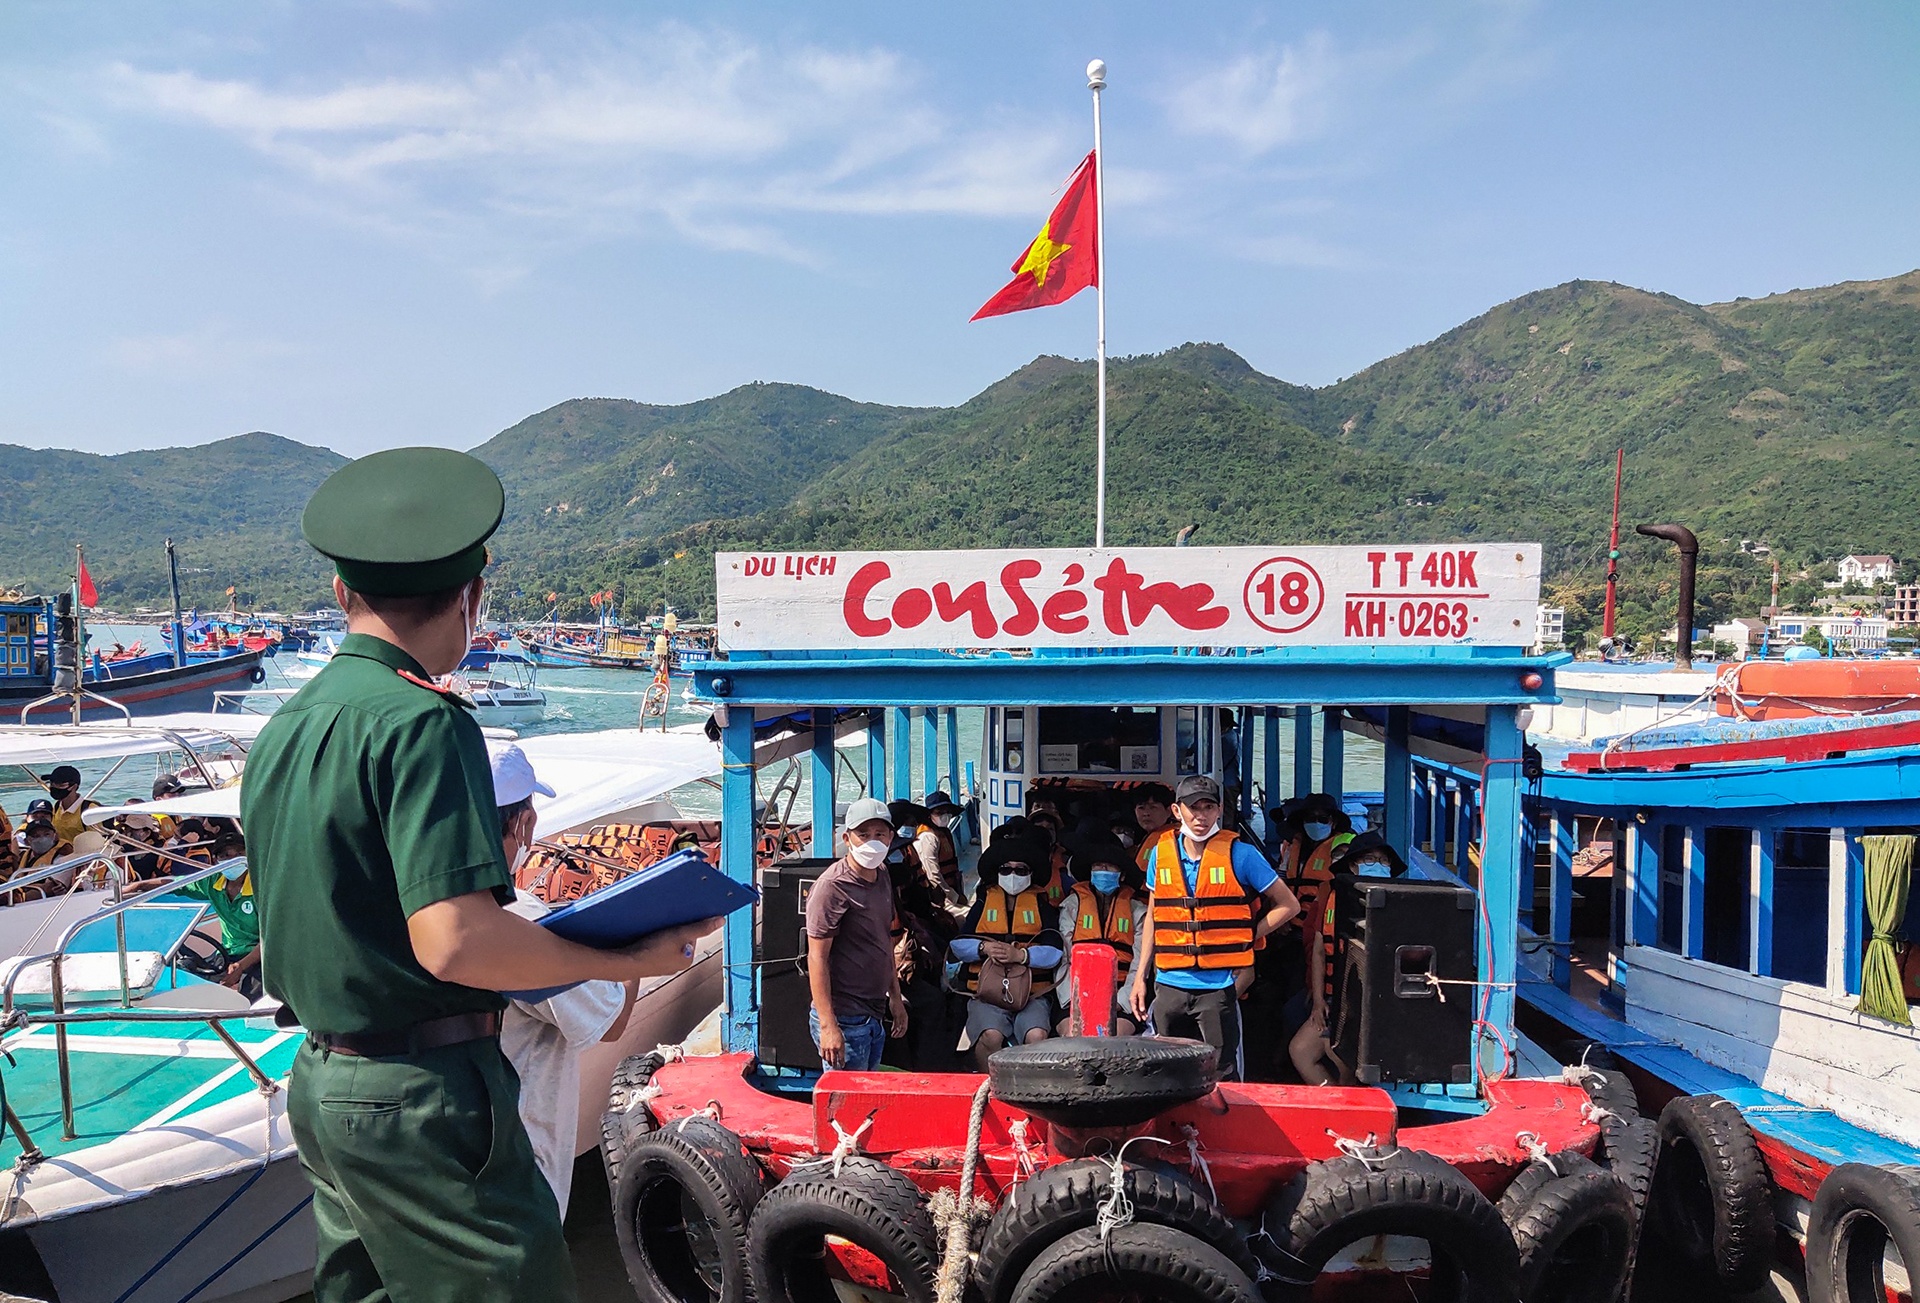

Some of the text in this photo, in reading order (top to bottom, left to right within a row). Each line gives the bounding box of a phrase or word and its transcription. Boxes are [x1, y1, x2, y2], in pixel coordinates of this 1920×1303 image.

[745, 556, 836, 580] DU LỊCH
[1256, 572, 1310, 616] 18
